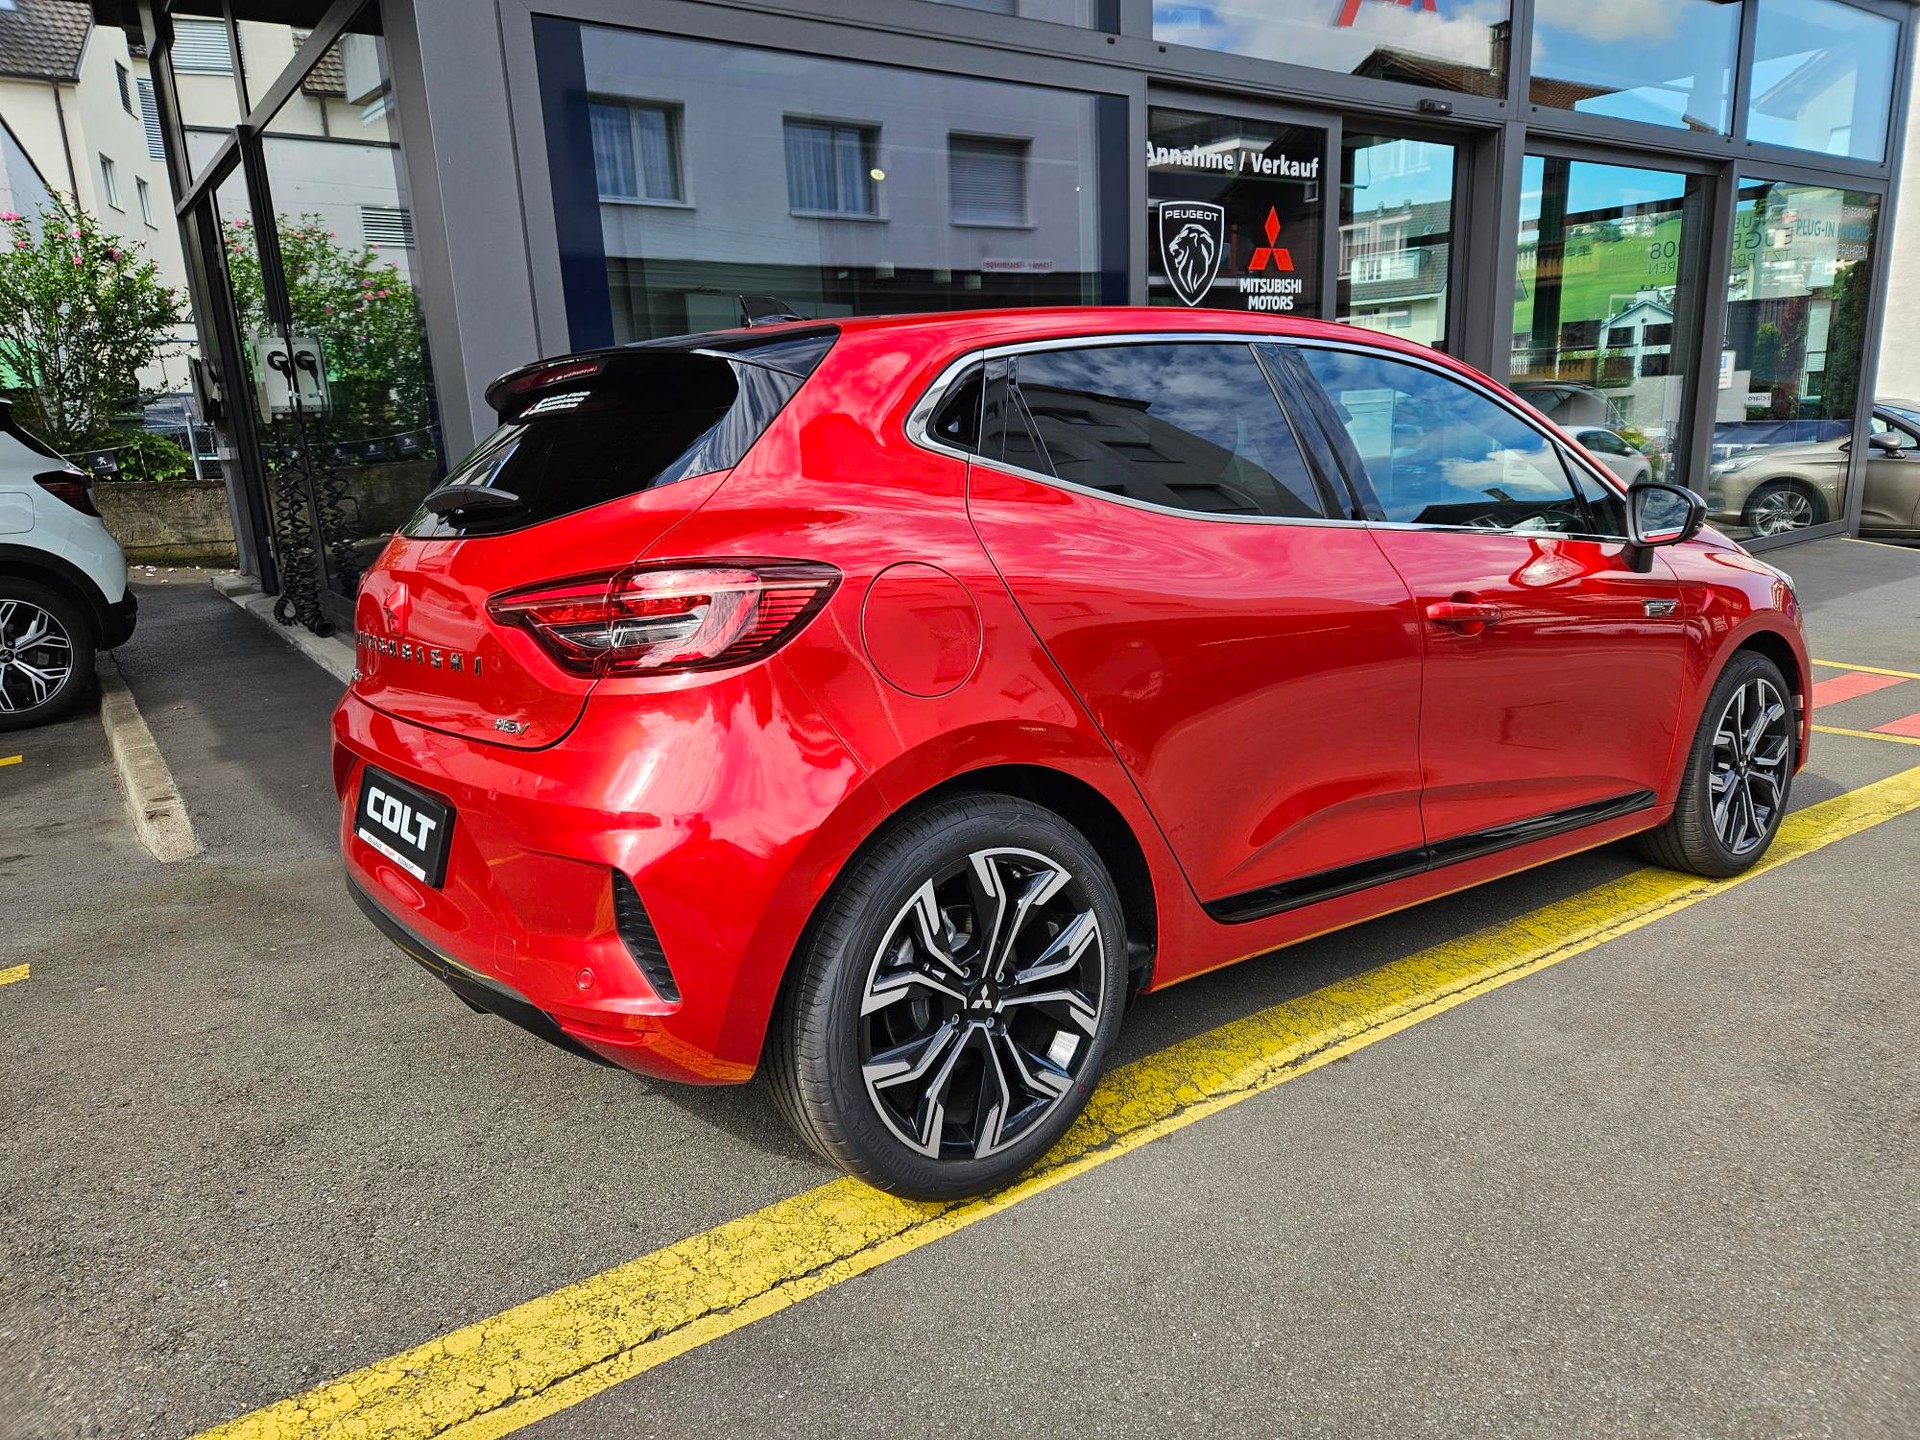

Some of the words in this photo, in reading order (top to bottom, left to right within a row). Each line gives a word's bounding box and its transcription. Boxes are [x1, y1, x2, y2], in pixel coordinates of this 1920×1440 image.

[1147, 141, 1234, 171] Annahme
[1239, 151, 1246, 172] /
[1250, 153, 1319, 179] Verkauf
[1165, 209, 1219, 222] PEUGEOT
[1796, 219, 1835, 238] PLUG-IN
[1239, 278, 1302, 294] MITSUBISHI
[1248, 296, 1294, 311] MOTORS
[495, 718, 530, 736] HEV
[366, 786, 437, 852] COLT
